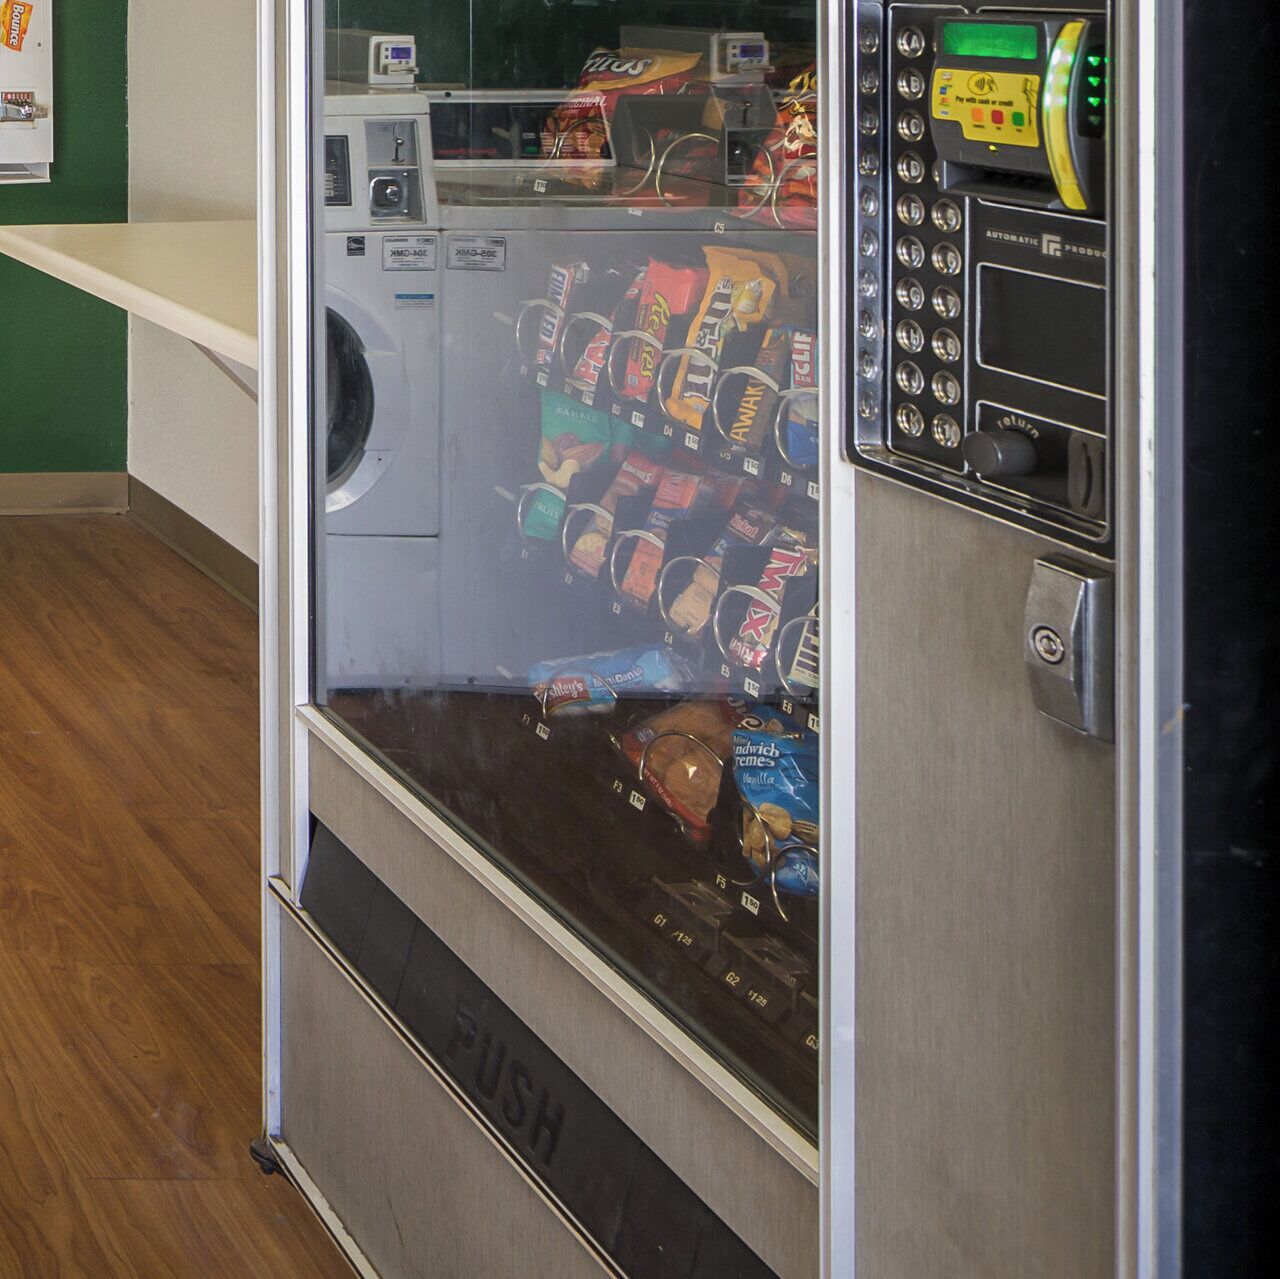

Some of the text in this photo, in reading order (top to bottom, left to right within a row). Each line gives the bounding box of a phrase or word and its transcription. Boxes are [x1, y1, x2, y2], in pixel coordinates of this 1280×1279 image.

[9, 2, 25, 47] Bounce
[955, 96, 965, 104] Pay
[986, 229, 1039, 246] AUTOMATIC
[792, 331, 815, 374] CLIF
[794, 375, 812, 385] BAR
[663, 425, 673, 437] D4
[997, 414, 1039, 439] return
[780, 472, 792, 487] D6
[565, 573, 573, 585] E2
[740, 546, 808, 641] TWIX
[612, 602, 622, 614] E3
[664, 632, 673, 645] E4
[782, 701, 793, 714] E6
[735, 755, 776, 768] remes
[742, 772, 775, 786] Vanilla
[613, 780, 623, 793] F3
[716, 874, 727, 889] F5
[654, 914, 667, 927] G1
[444, 1001, 567, 1166] PUSH
